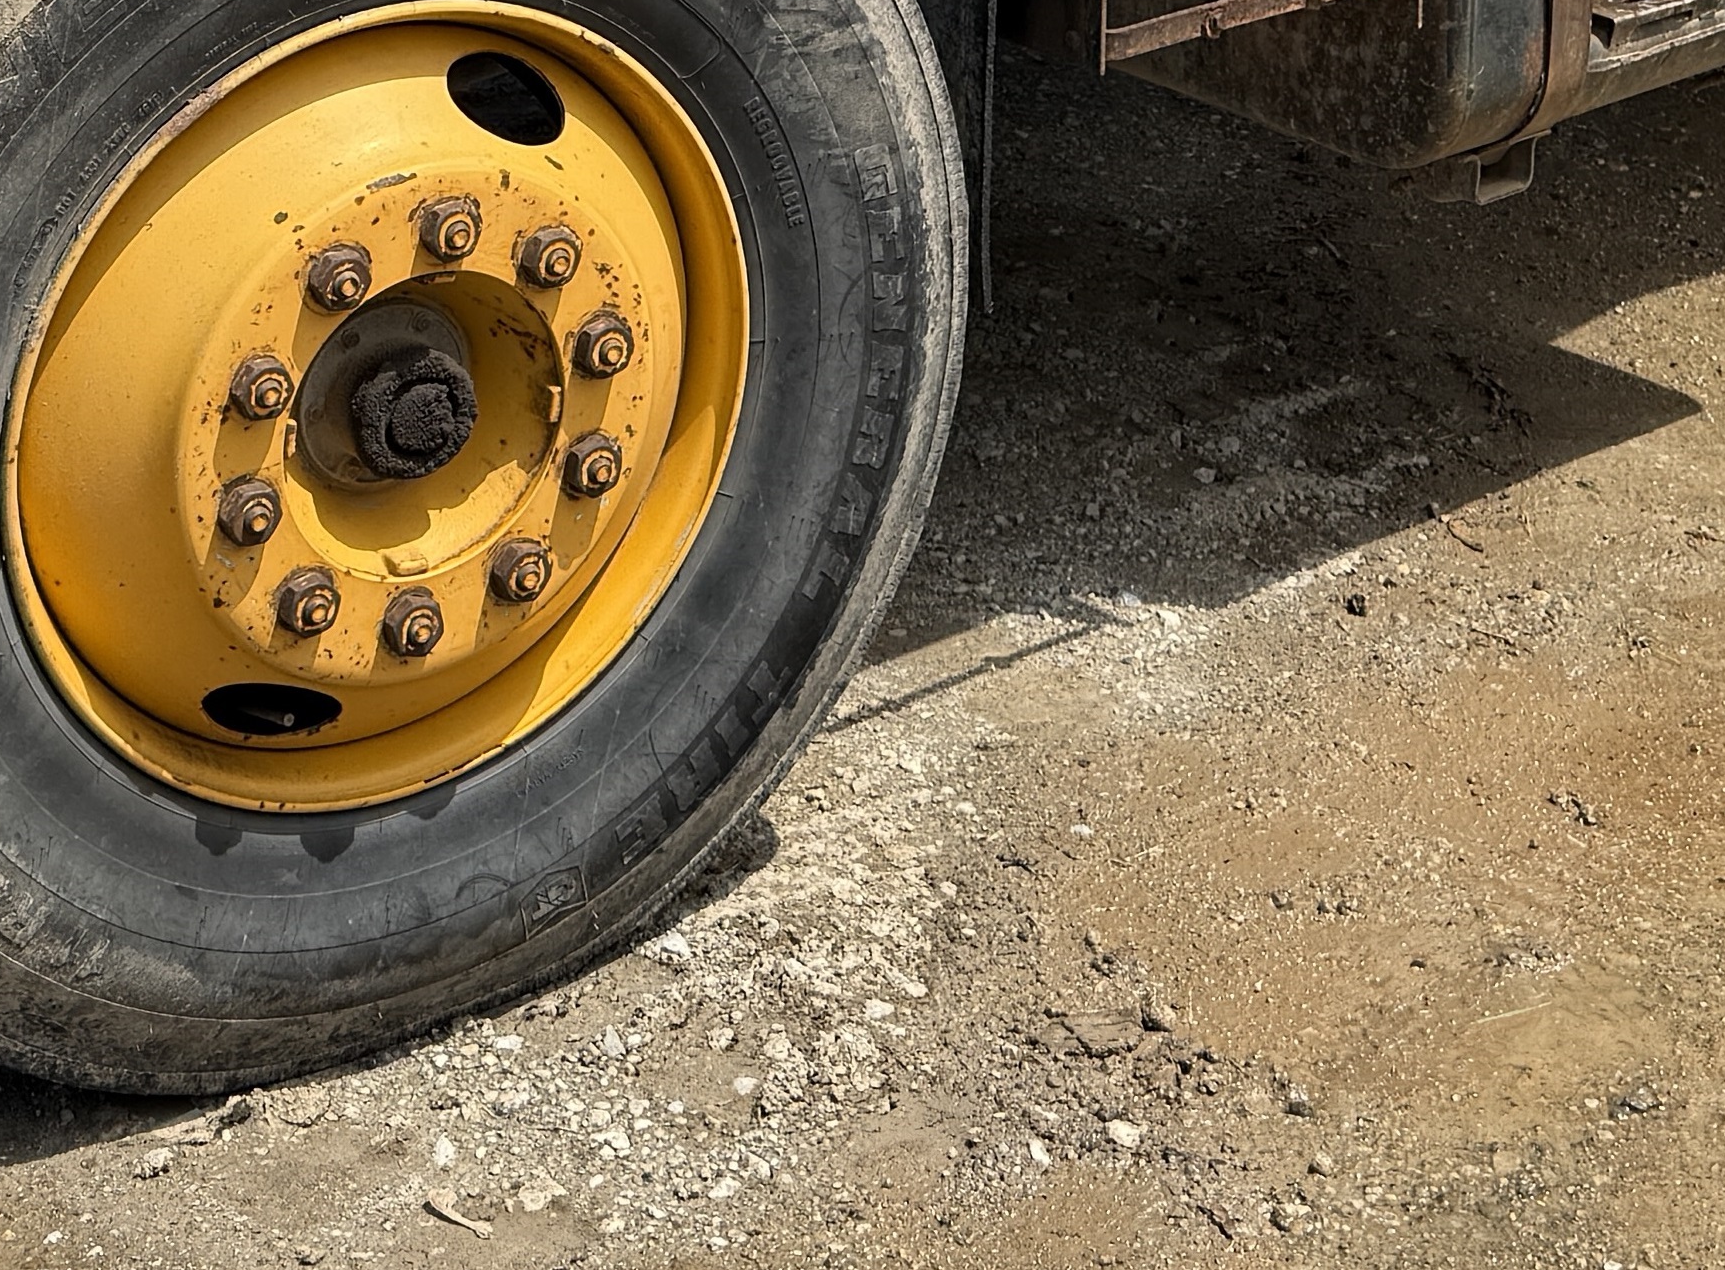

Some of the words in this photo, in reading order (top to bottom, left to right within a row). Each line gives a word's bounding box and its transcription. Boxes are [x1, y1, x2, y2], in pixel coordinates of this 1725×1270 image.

[743, 95, 806, 229] REGROOVABLE
[801, 143, 905, 600] GENERAL
[615, 659, 793, 865] TIRE
